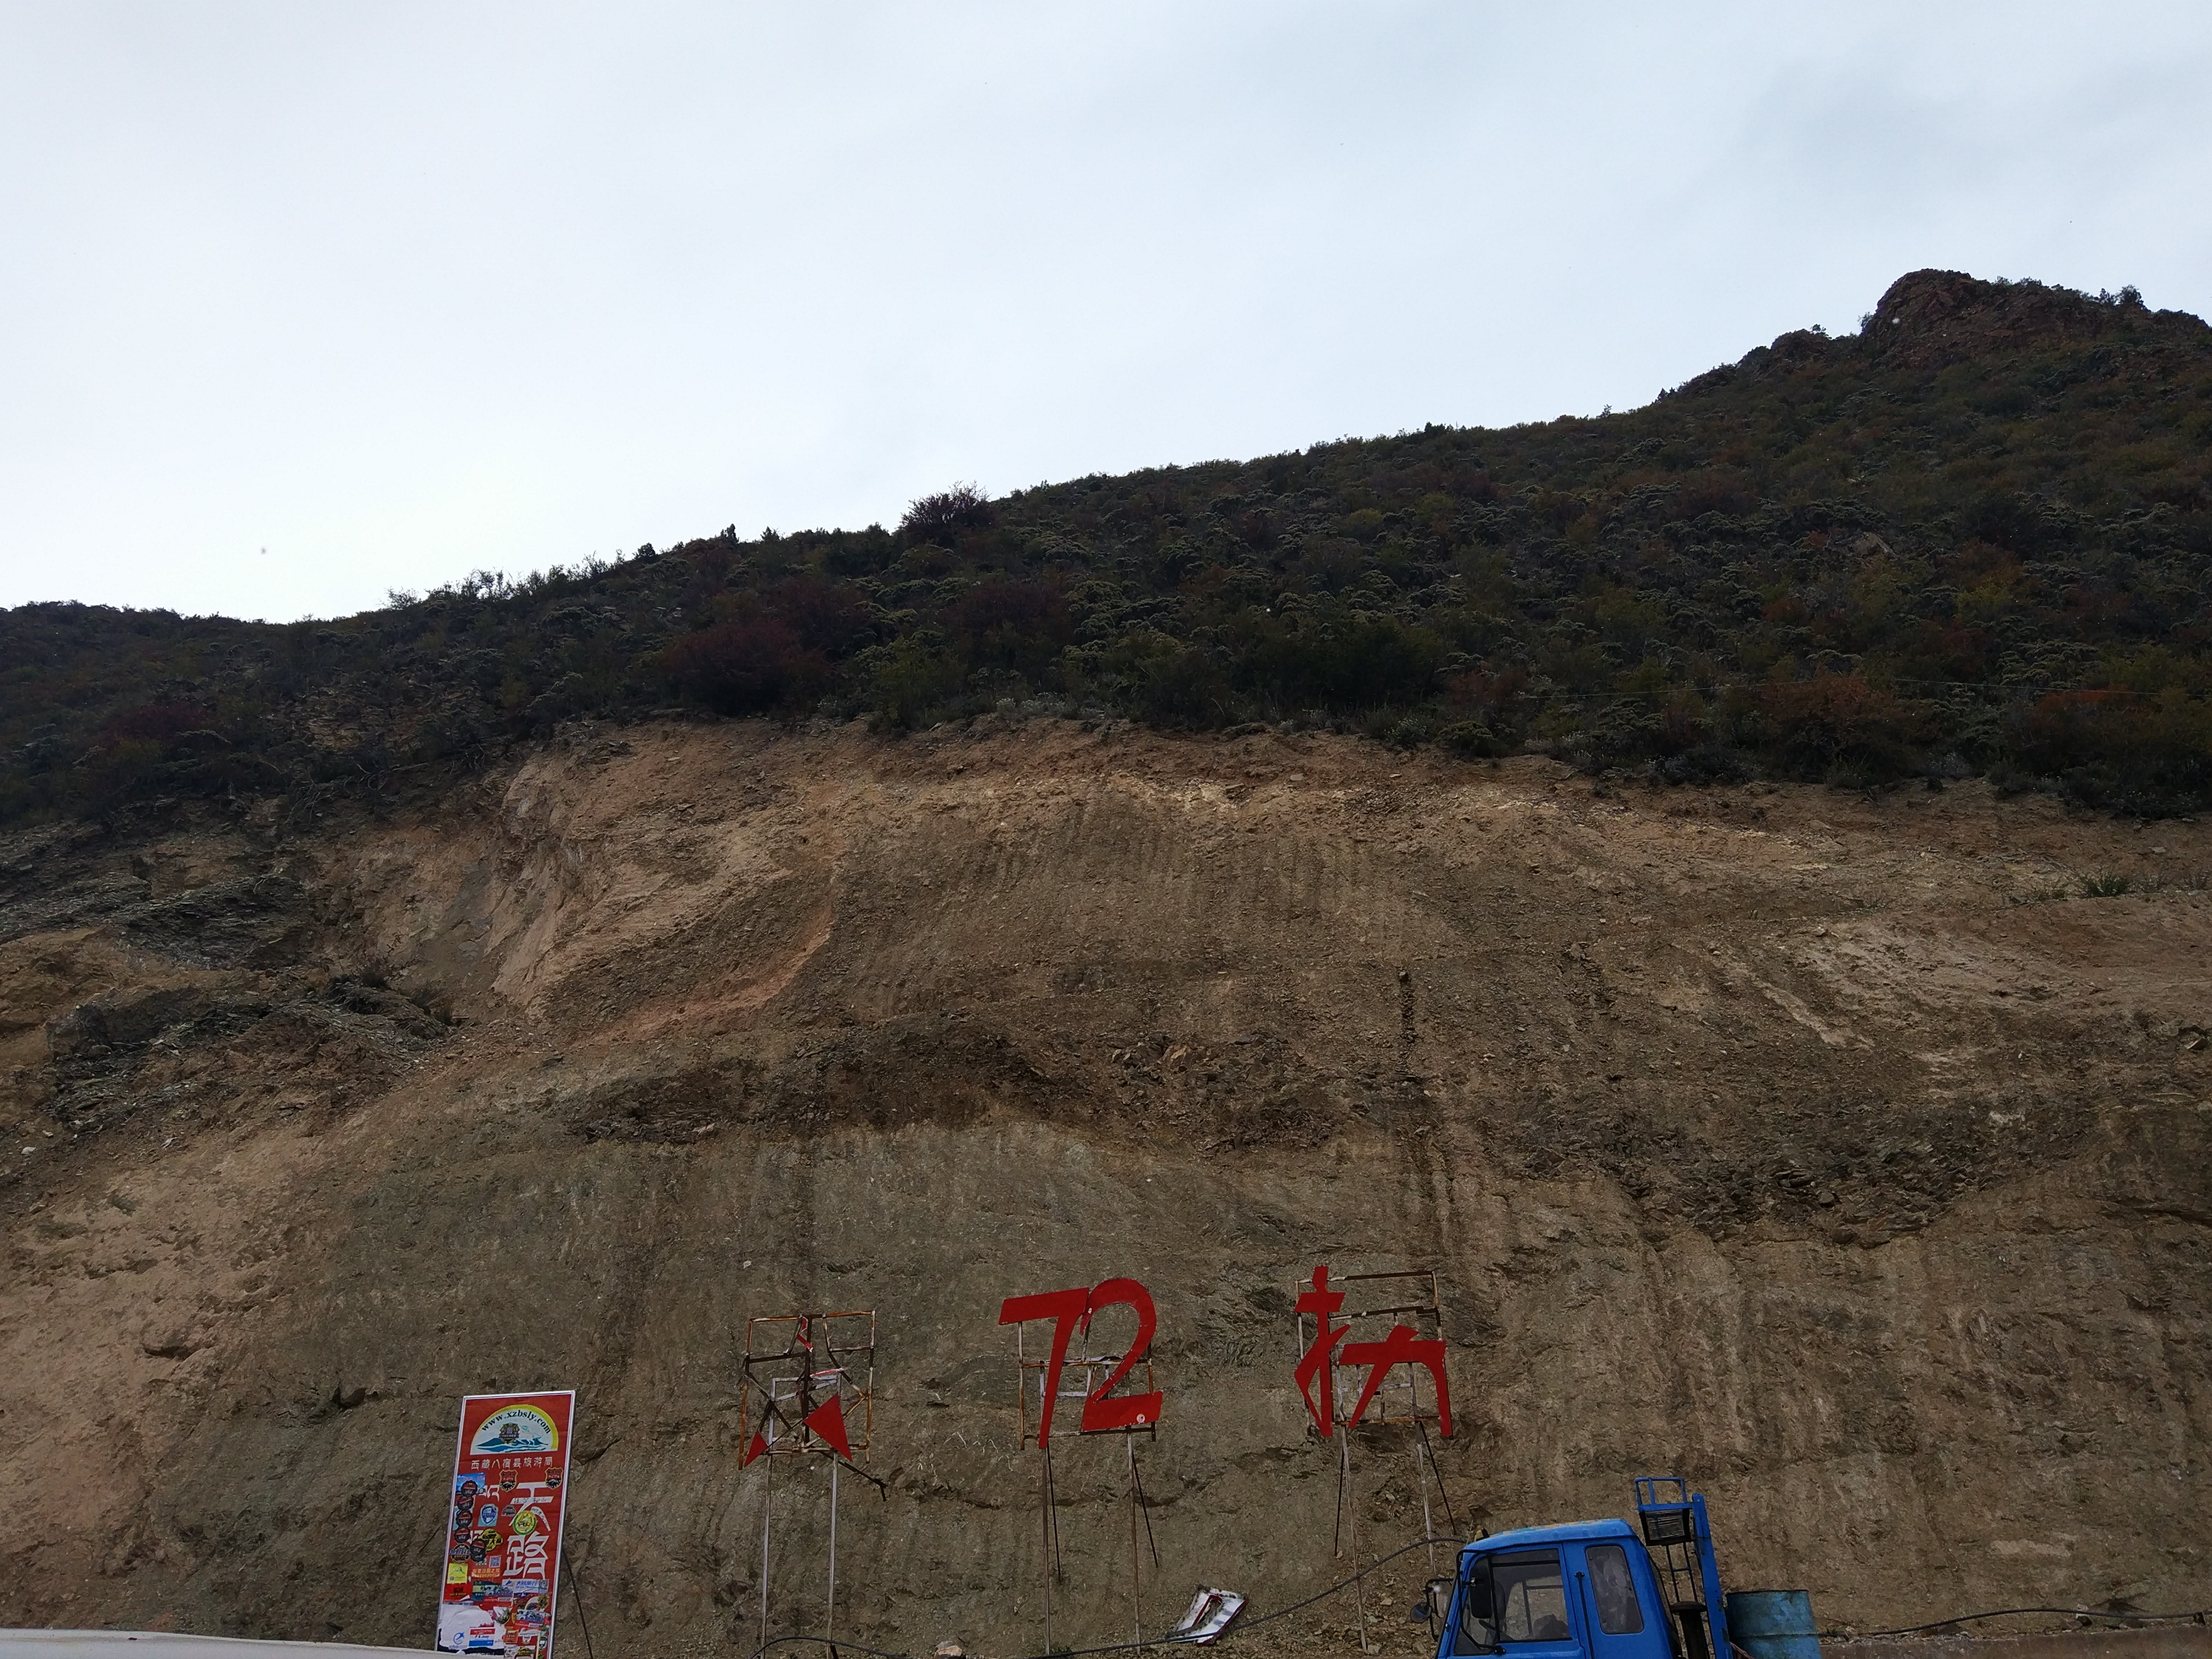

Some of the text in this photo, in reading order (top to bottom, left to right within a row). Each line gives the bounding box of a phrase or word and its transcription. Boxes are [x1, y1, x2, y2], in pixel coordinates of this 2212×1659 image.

[481, 1410, 551, 1435] www.xzbsly.com
[471, 1456, 553, 1470] 西藏八宿县旅游局
